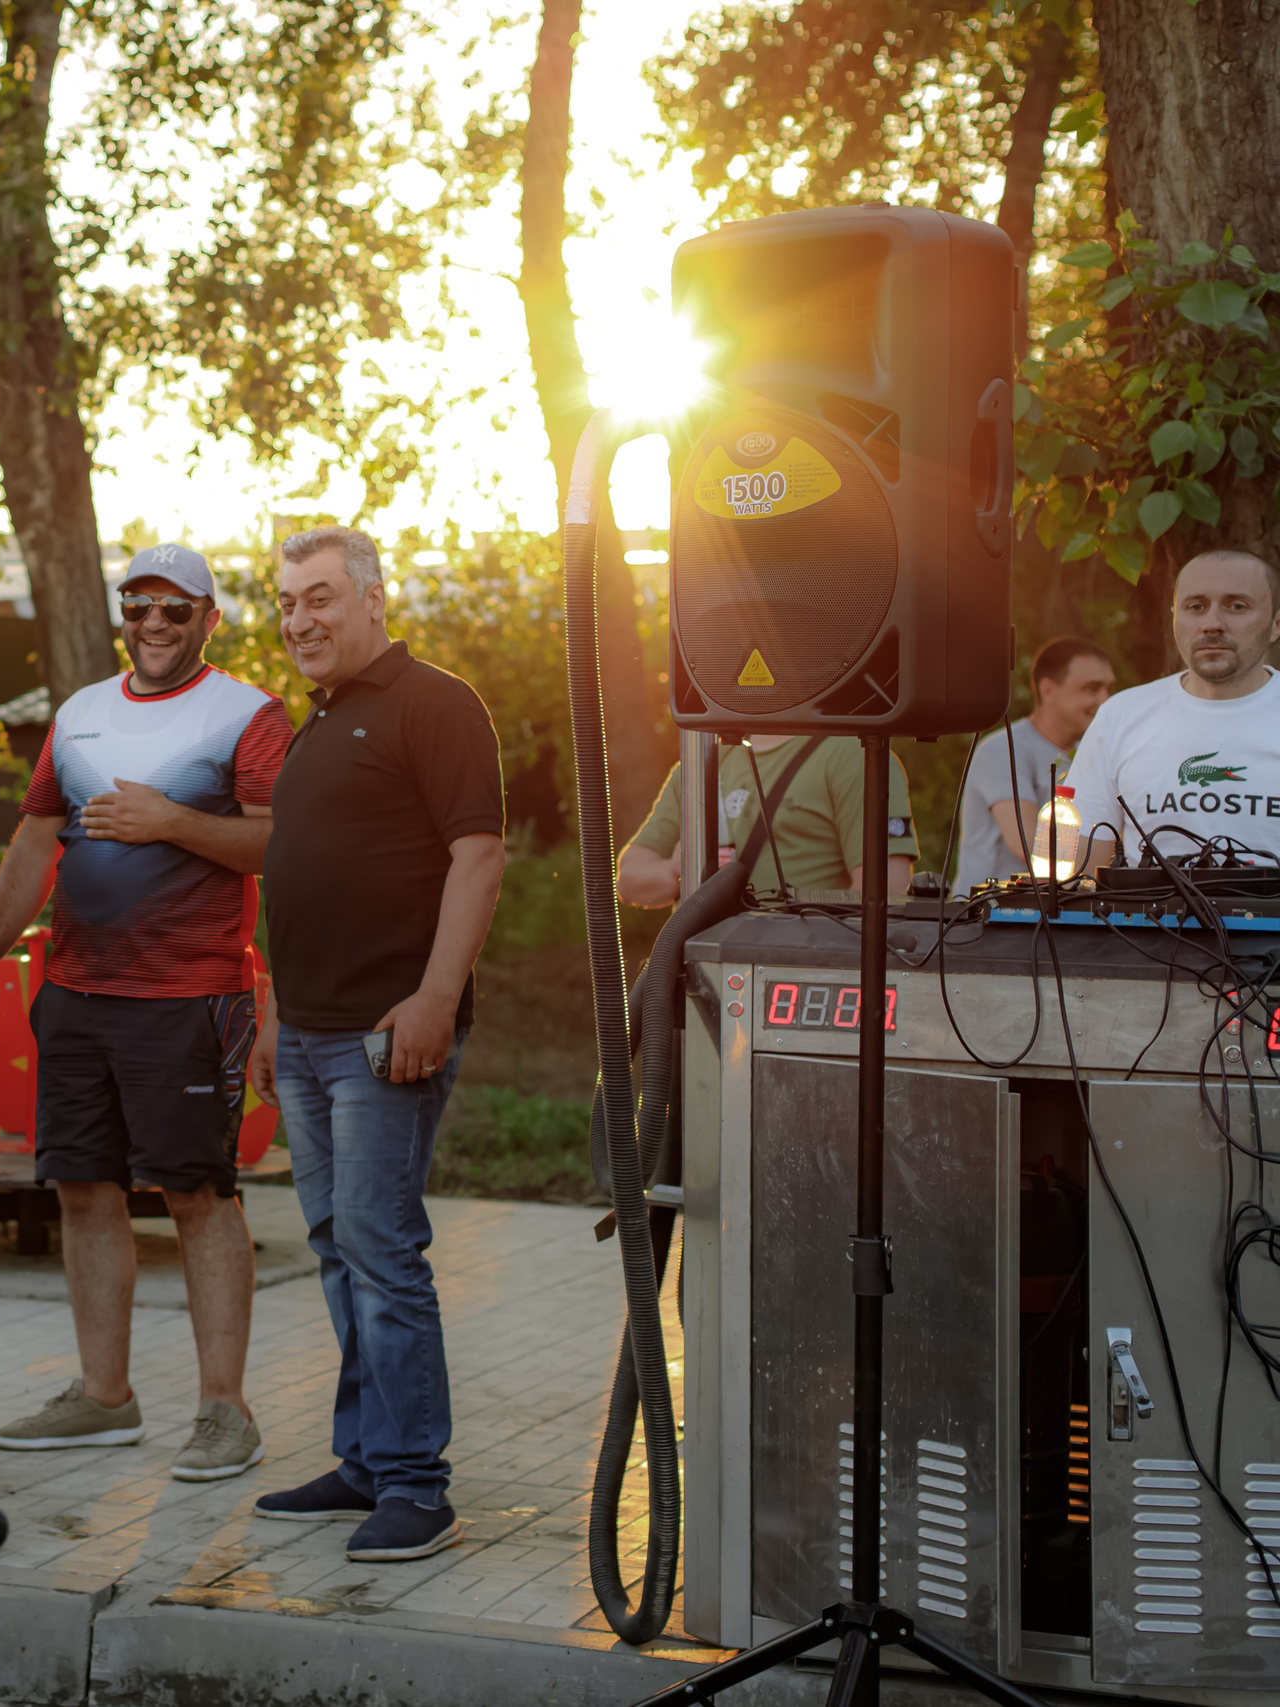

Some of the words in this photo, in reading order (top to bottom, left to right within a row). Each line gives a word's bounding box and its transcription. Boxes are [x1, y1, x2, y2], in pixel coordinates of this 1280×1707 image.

[744, 435, 770, 449] 1500
[723, 471, 786, 505] 1500
[734, 502, 772, 515] WATTS
[1146, 792, 1280, 817] LACOSTE
